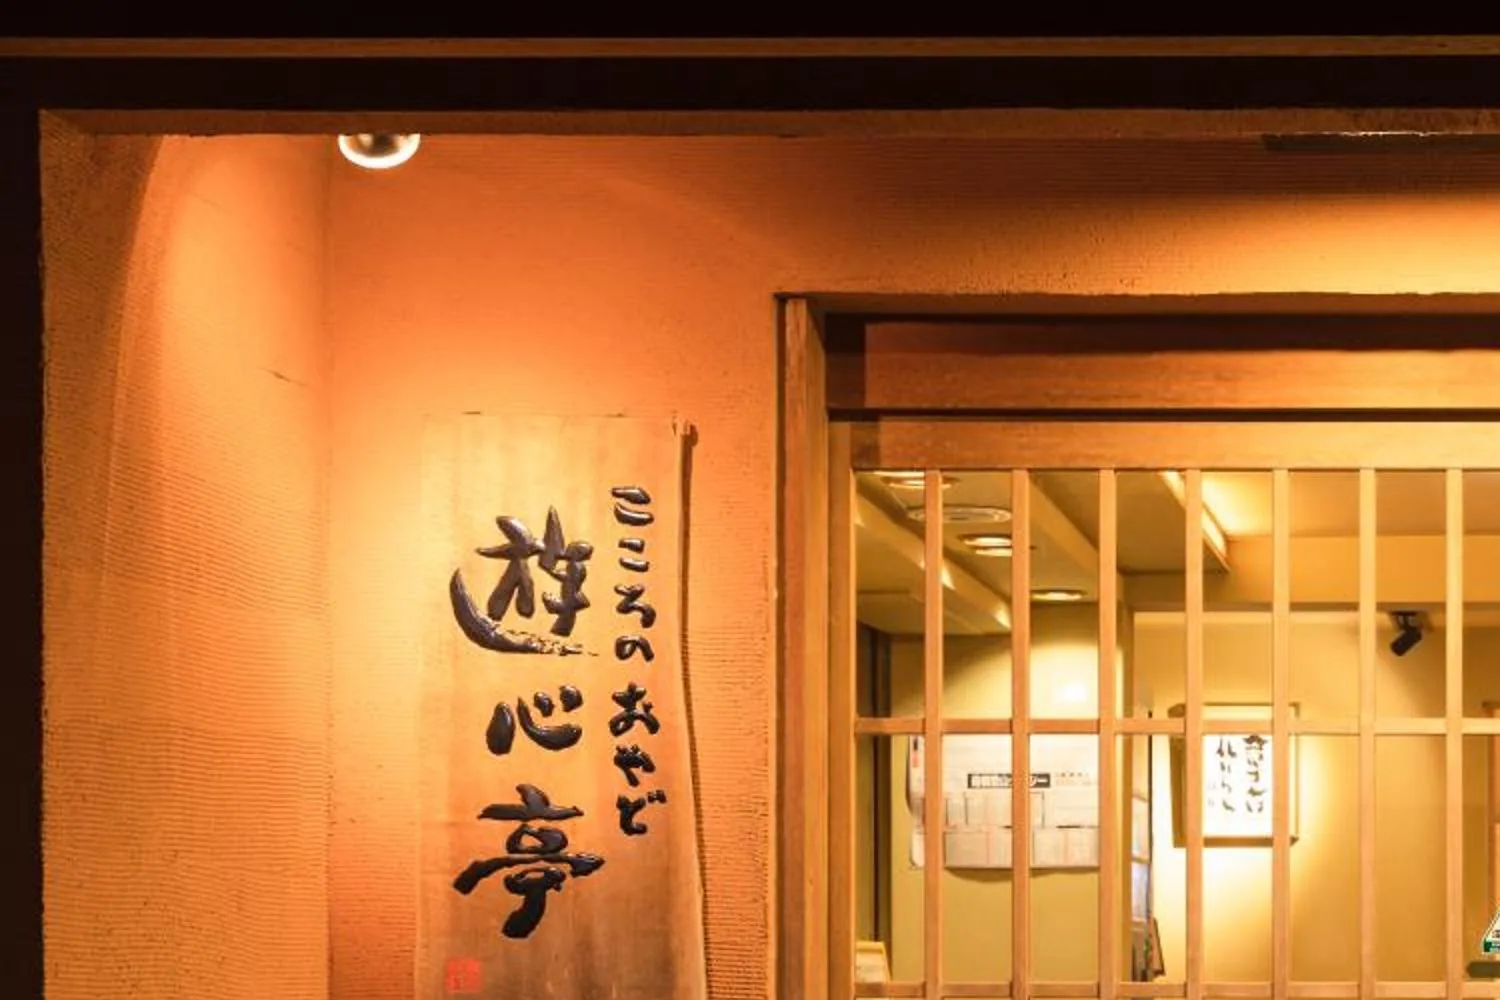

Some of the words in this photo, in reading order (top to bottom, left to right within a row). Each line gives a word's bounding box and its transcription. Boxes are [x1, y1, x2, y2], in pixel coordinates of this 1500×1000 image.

[609, 485, 666, 835] こころのおやど
